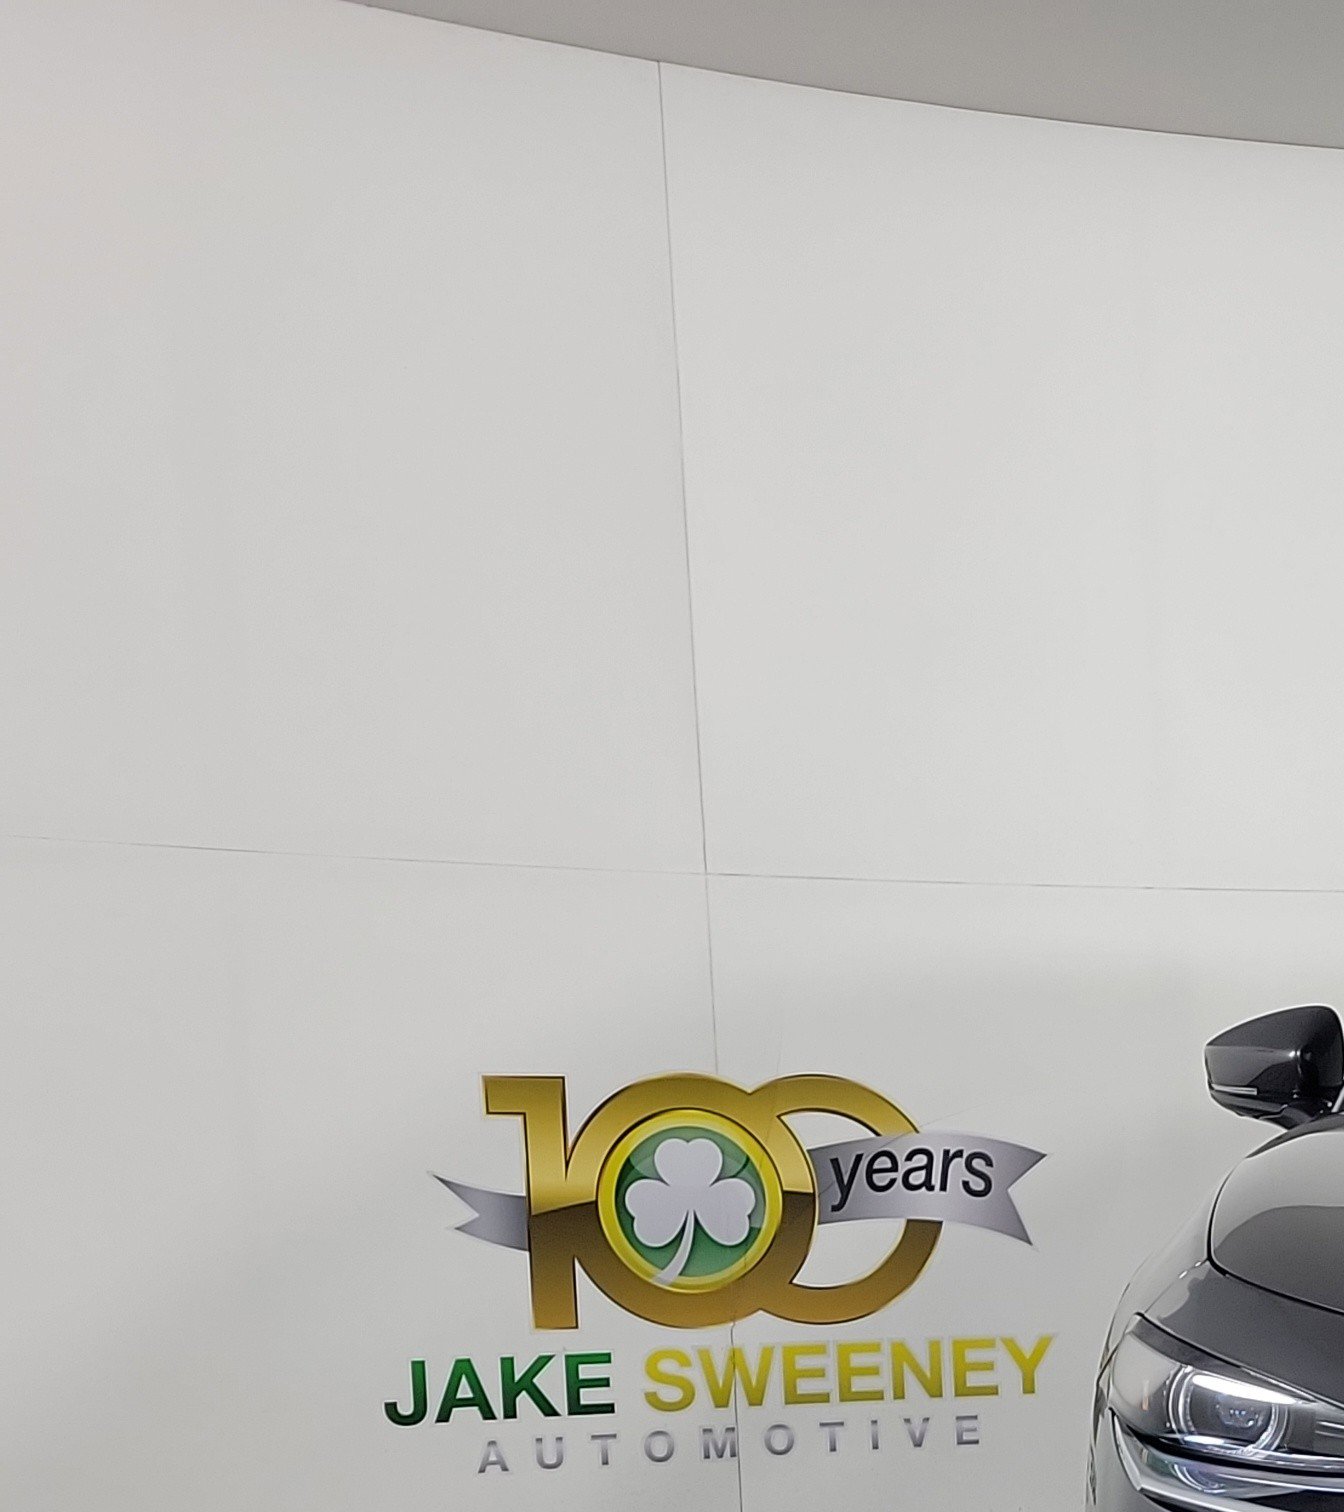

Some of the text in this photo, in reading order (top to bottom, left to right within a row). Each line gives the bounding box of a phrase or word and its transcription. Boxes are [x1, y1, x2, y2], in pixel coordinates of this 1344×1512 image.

[482, 1072, 945, 1330] 100
[829, 1145, 995, 1212] years
[383, 1335, 1055, 1427] JAKE SWEENEY
[477, 1415, 982, 1475] AUTOMOTIVE
